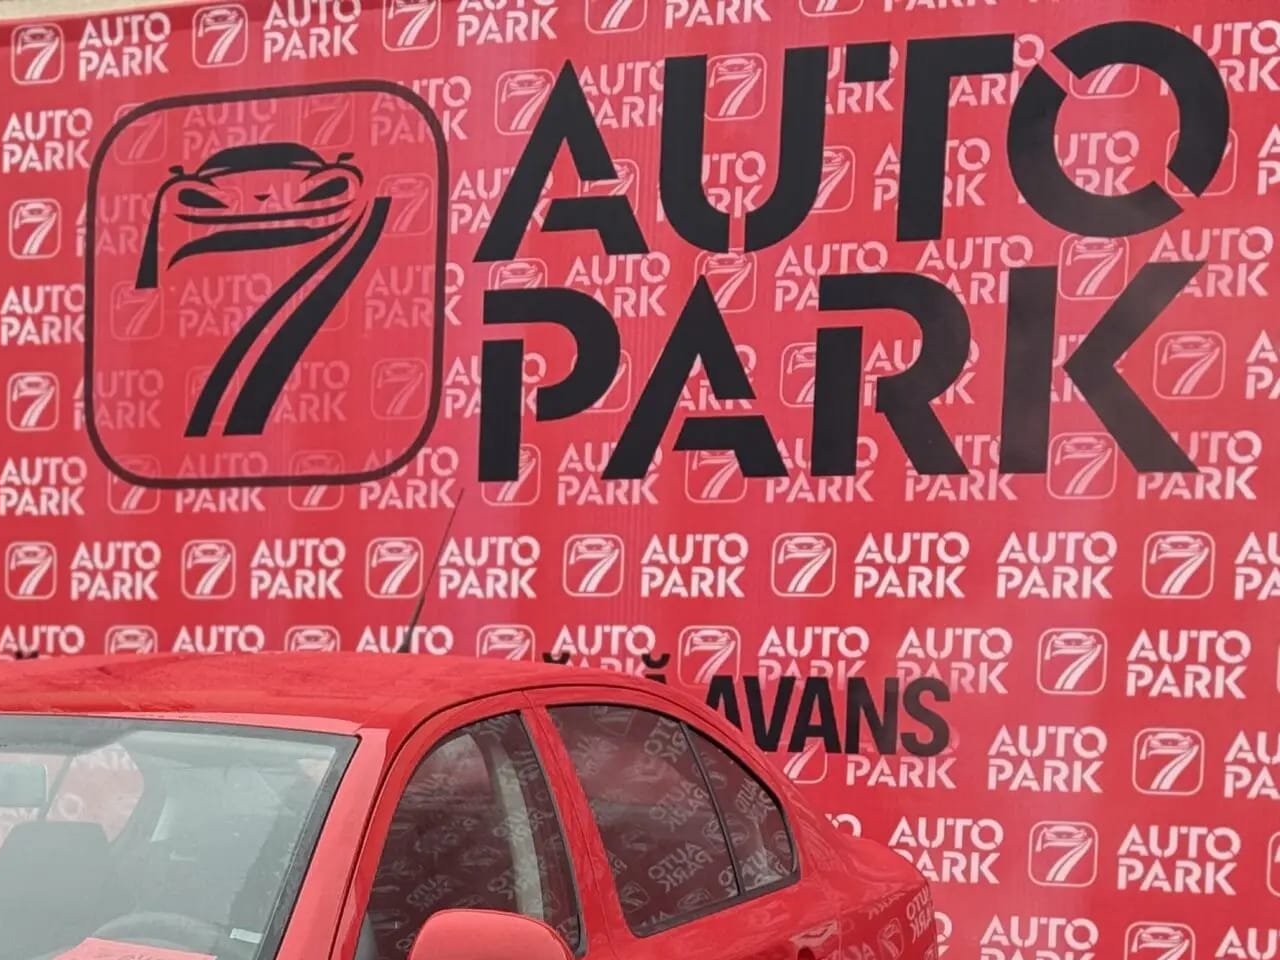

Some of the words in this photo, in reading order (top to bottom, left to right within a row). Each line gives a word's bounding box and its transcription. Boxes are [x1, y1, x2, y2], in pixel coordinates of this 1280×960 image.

[79, 12, 171, 49] AUTO
[263, 0, 361, 30] AUTO
[457, 12, 558, 46] PARK
[665, 0, 771, 29] PARK
[264, 25, 359, 63] PARK
[79, 42, 168, 81] PARK
[2, 108, 93, 143] AUTO
[473, 21, 1230, 262] AUTO
[2, 139, 91, 173] PARK
[915, 235, 1033, 269] AUTO
[1150, 227, 1273, 263] AUTO
[568, 250, 670, 287] AUTO
[0, 283, 85, 316] AUTO
[0, 314, 85, 346] PARK
[477, 260, 1207, 482] PARK
[0, 486, 84, 516] PARK
[360, 478, 455, 510] PARK
[557, 476, 659, 507] PARK
[70, 540, 161, 570] AUTO
[250, 537, 346, 568] AUTO
[438, 536, 540, 567] AUTO
[640, 533, 748, 565] AUTO
[854, 531, 970, 564] AUTO
[997, 531, 1117, 564] AUTO
[71, 571, 158, 600] PARK
[250, 567, 343, 599] PARK
[439, 568, 537, 599] PARK
[641, 566, 745, 598] PARK
[854, 565, 966, 598] PARK
[997, 566, 1113, 599] PARK
[357, 625, 455, 652] AUTO
[552, 625, 657, 657] AUTO
[759, 626, 869, 659] AUTO
[898, 628, 1012, 660] AUTO
[1127, 629, 1251, 664] AUTO
[1126, 663, 1246, 699] PARK
[988, 725, 1107, 759] AUTO
[846, 754, 957, 788] PARK
[988, 758, 1103, 793] PARK
[889, 816, 1003, 850] AUTO
[1117, 824, 1241, 861] AUTO
[1117, 857, 1237, 895] PARK
[980, 915, 1099, 950] AUTO
